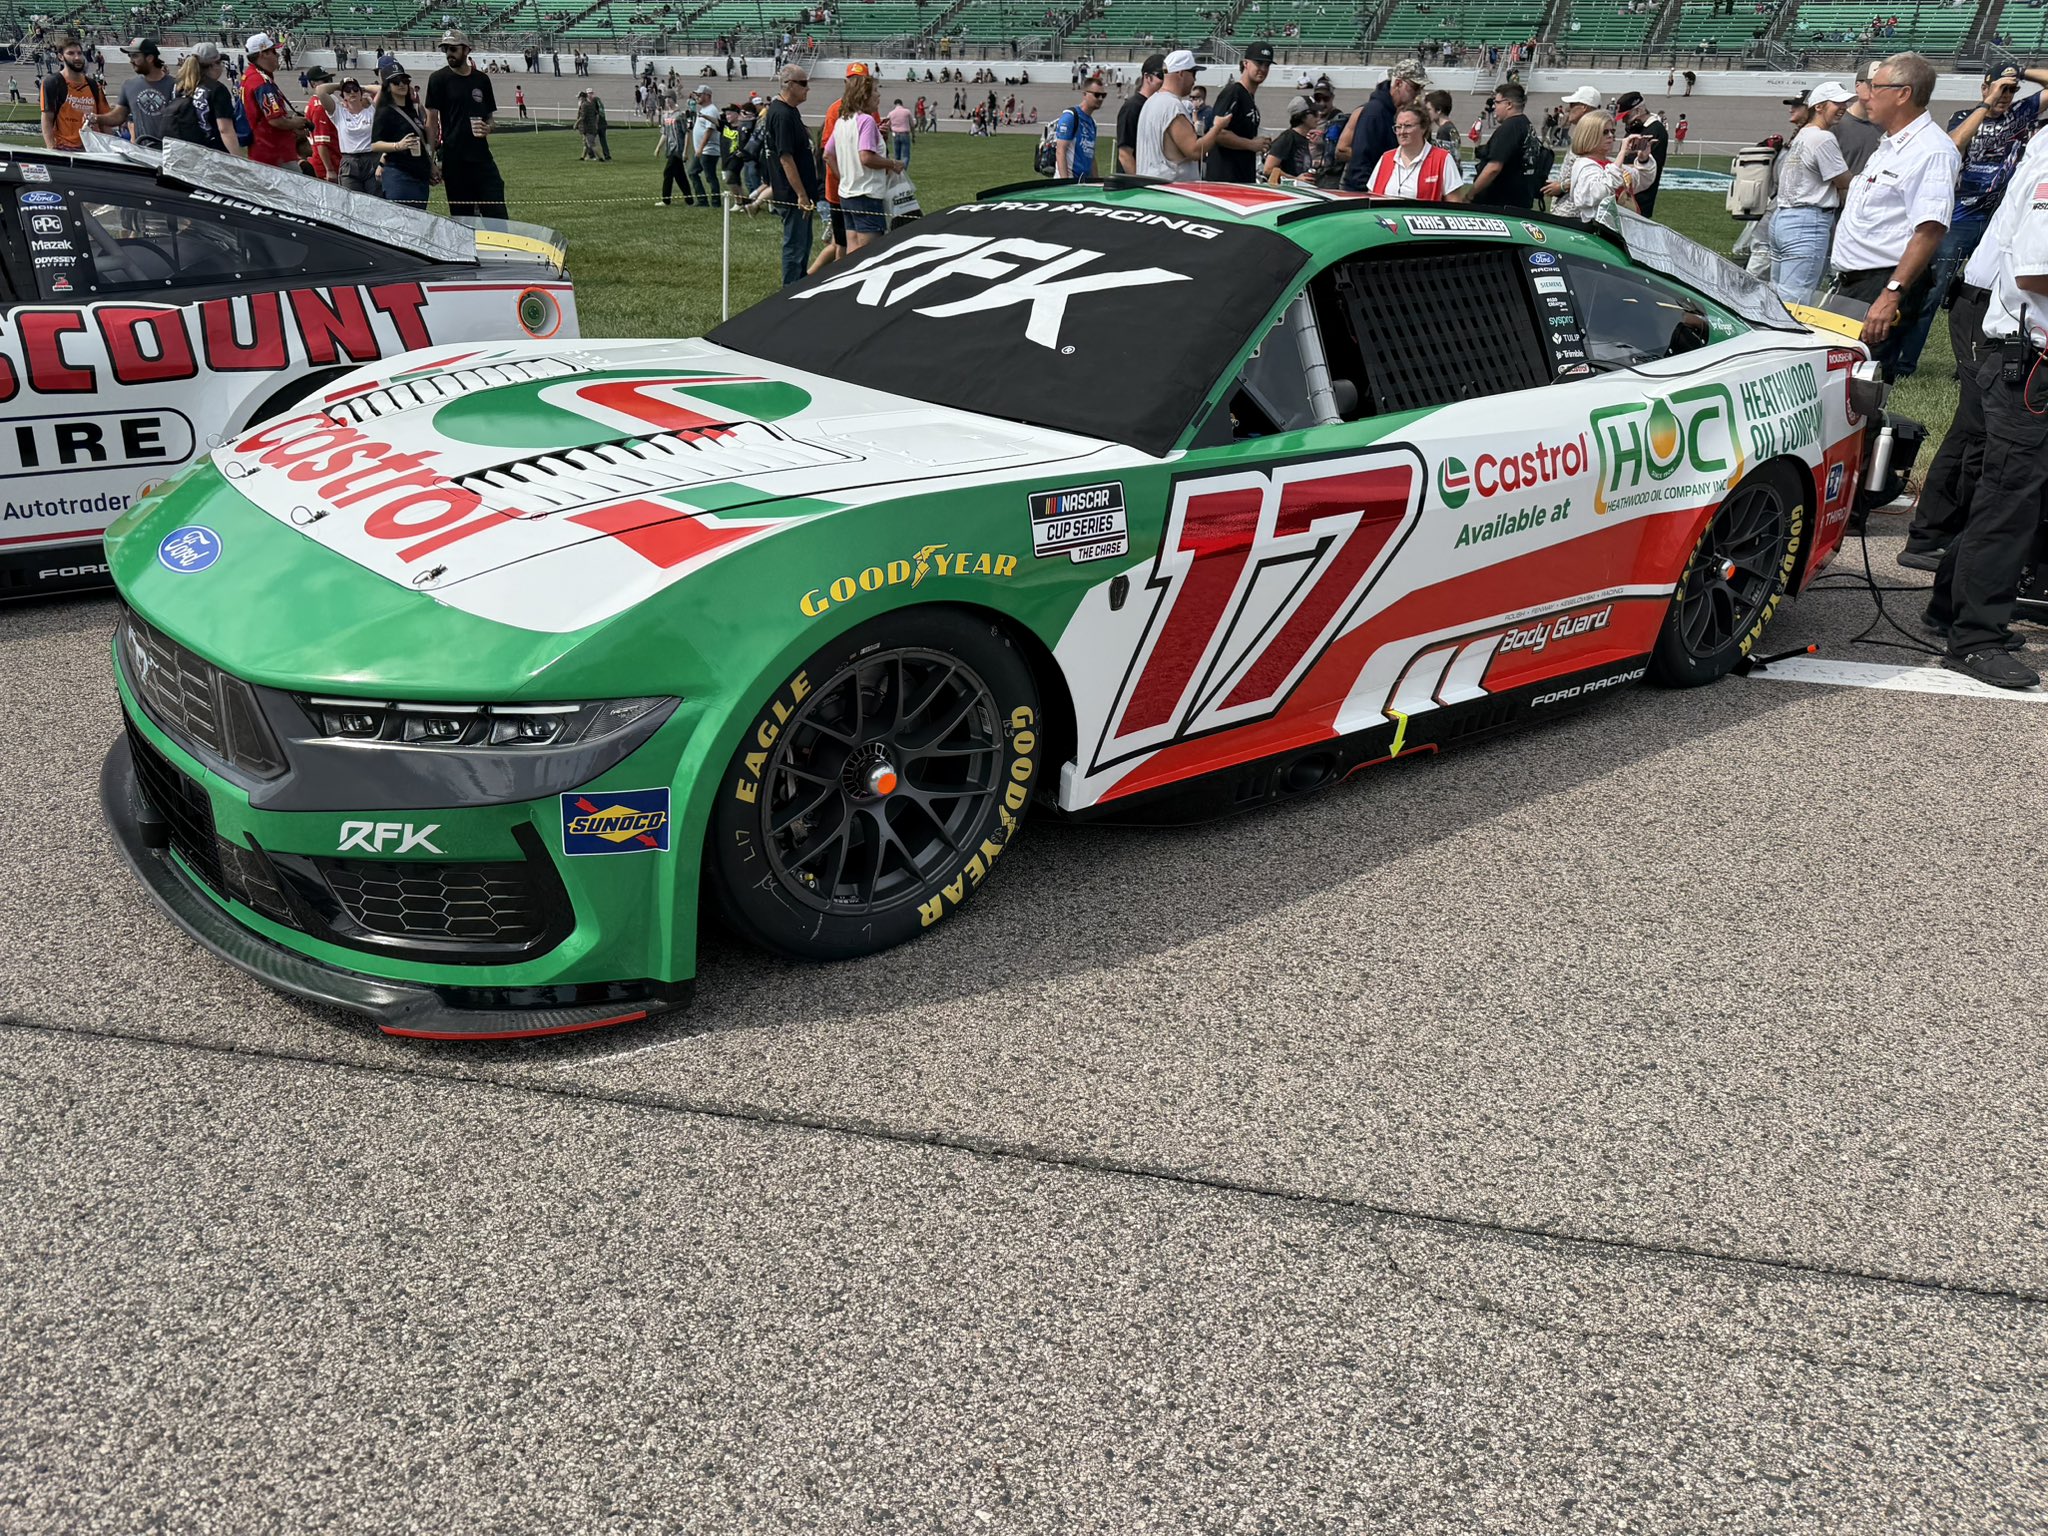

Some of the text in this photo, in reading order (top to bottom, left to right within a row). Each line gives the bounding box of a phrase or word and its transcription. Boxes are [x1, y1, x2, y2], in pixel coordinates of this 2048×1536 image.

[25, 192, 57, 203] Ford
[34, 217, 60, 231] PPG
[1403, 215, 1508, 232] CHRIS BUESCHER
[31, 240, 73, 251] Mazak
[35, 256, 77, 264] ODYSSEY
[1533, 253, 1552, 264] Ford
[789, 233, 1194, 350] RFK
[1548, 316, 1574, 327] syspro
[1562, 334, 1580, 342] TULIP
[0, 281, 433, 403] COUNT
[1562, 349, 1585, 358] Trimble
[1739, 362, 1818, 421] HEATHWOOD
[1750, 421, 1779, 461] OIL
[1474, 432, 1588, 498] Castrol
[233, 411, 529, 564] Castrol
[1061, 489, 1110, 513] NASCAR
[1606, 479, 1727, 513] HEATHWOOD OIL COMPANY INC
[3, 493, 131, 521] Autotrader
[1454, 498, 1571, 549] Available at
[1047, 514, 1114, 541] CUP SERIES
[162, 529, 214, 568] Ford
[1079, 541, 1122, 559] THE CHASE
[799, 543, 1018, 618] GOODYEAR
[1738, 504, 1804, 657] GOODYEAR
[1098, 455, 1420, 760] 17
[1504, 611, 1526, 621] ROUSH
[1531, 603, 1555, 615] FENWAY
[1601, 587, 1625, 597] RACING
[1499, 604, 1613, 654] Body Guard
[1530, 667, 1647, 708] FORD RACING
[735, 670, 812, 803] EAGLE
[571, 812, 664, 833] SUNOCO
[916, 705, 1035, 928] GOODYEAR
[336, 820, 444, 854] RFK
